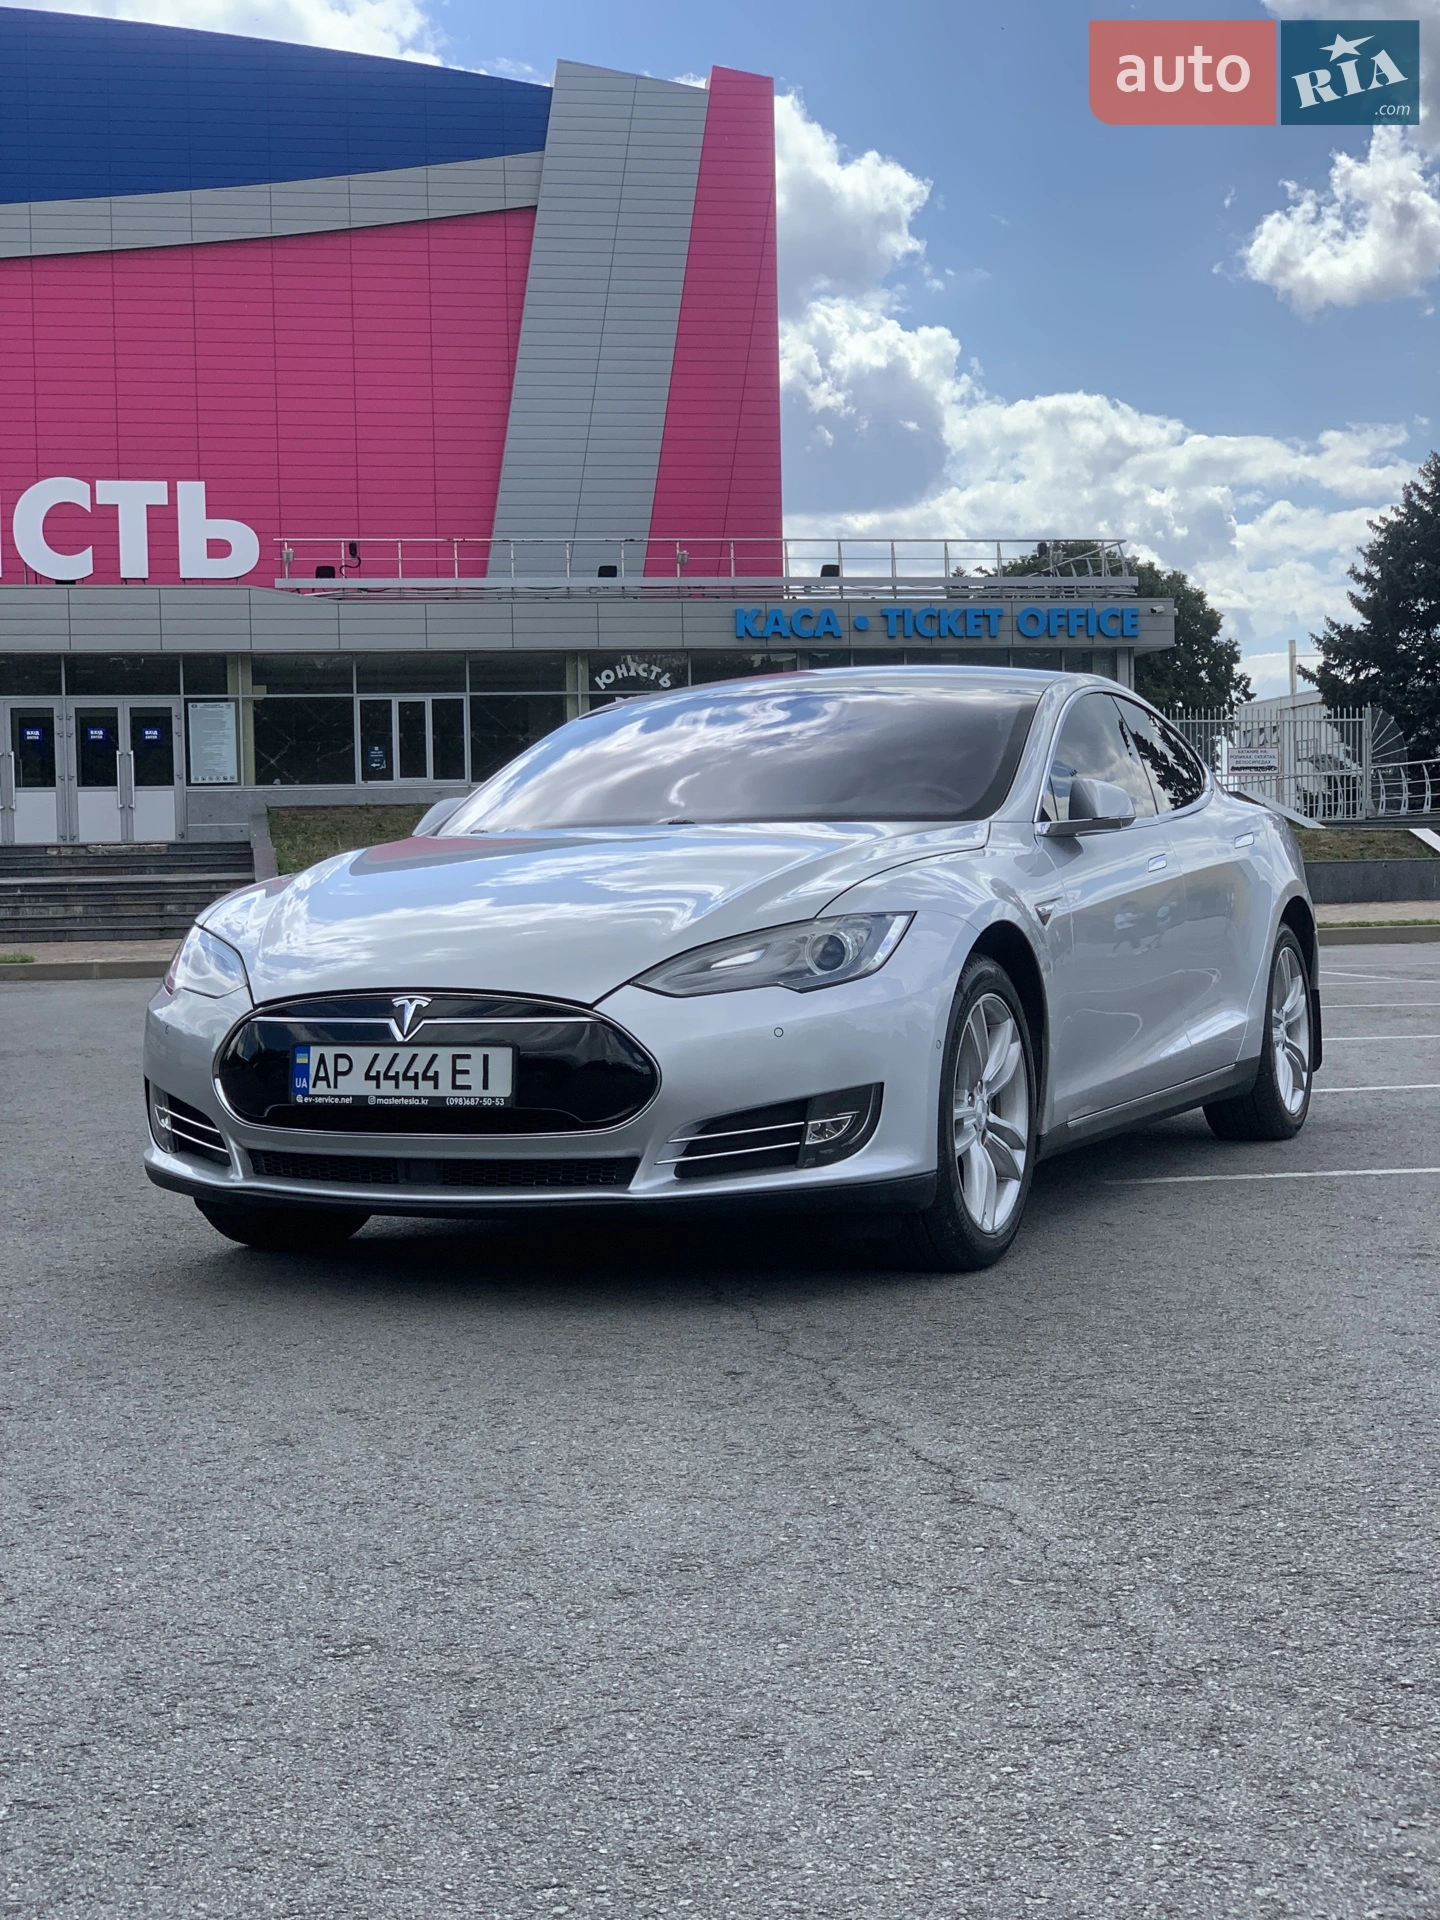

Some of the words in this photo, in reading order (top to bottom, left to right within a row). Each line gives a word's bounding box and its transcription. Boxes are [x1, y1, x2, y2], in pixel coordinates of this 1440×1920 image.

[0, 476, 260, 581] СТЬ
[735, 608, 843, 638] КАСА
[880, 607, 1004, 638] TICKET
[1017, 607, 1141, 638] OFFICE
[594, 662, 672, 690] ЮНІСТЬ
[312, 1053, 353, 1089] AP
[364, 1053, 439, 1090] 4444
[451, 1053, 490, 1090] EI
[295, 1077, 308, 1088] UA
[304, 1096, 353, 1104] ev-service.net
[376, 1097, 429, 1106] mastertesla.kr
[446, 1096, 505, 1106] (098)687-50-53
